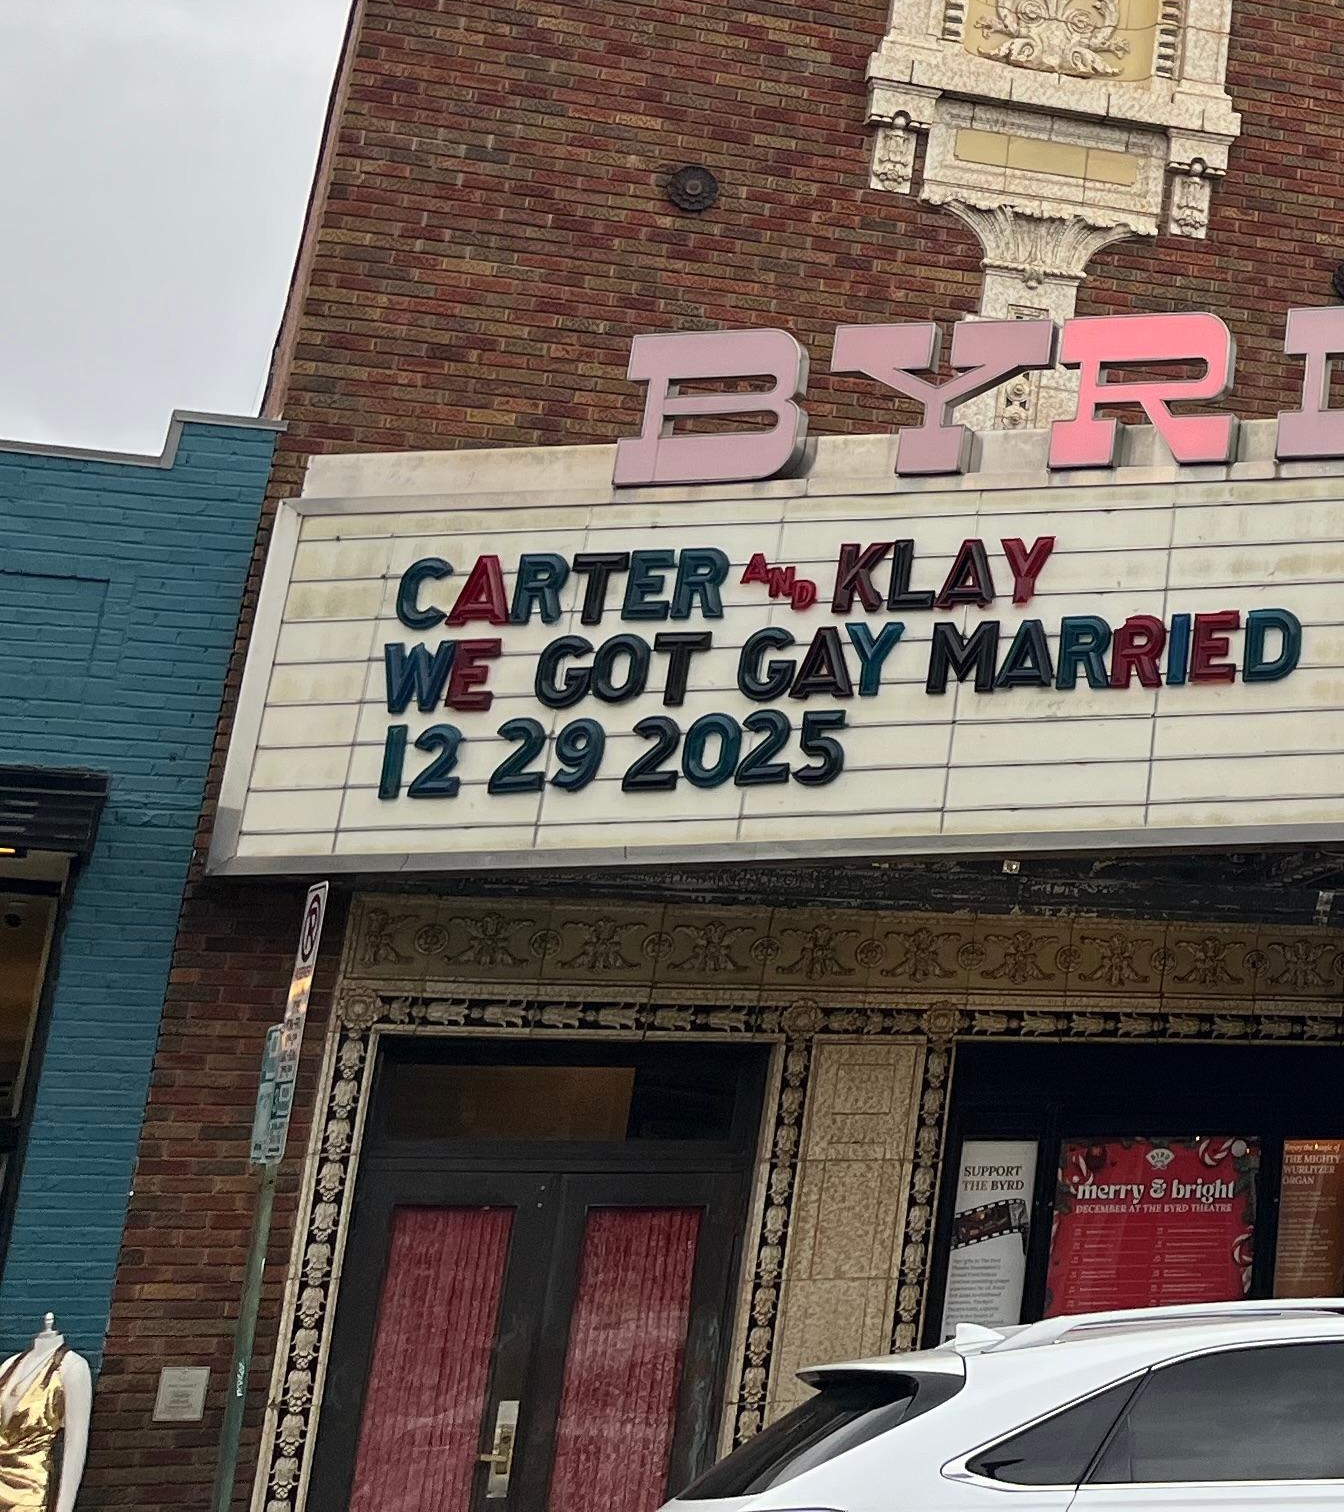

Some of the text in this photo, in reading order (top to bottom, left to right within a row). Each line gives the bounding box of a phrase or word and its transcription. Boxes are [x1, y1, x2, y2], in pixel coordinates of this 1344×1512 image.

[396, 536, 1056, 630] CARTER AND KLAY
[384, 608, 1301, 713] WE GOT GAY MARRIED
[378, 708, 848, 800] 12 29 2025
[1285, 1154, 1341, 1164] THE MIGHTY
[964, 1165, 1022, 1177] SUPPORT
[1283, 1165, 1335, 1174] WURLITZER
[962, 1179, 1025, 1191] THE BYRD
[1282, 1175, 1315, 1185] ORGAN
[1076, 1178, 1235, 1204] merry & bright
[1075, 1203, 1233, 1214] DECEMBER AT THE BYRD THEATRE
